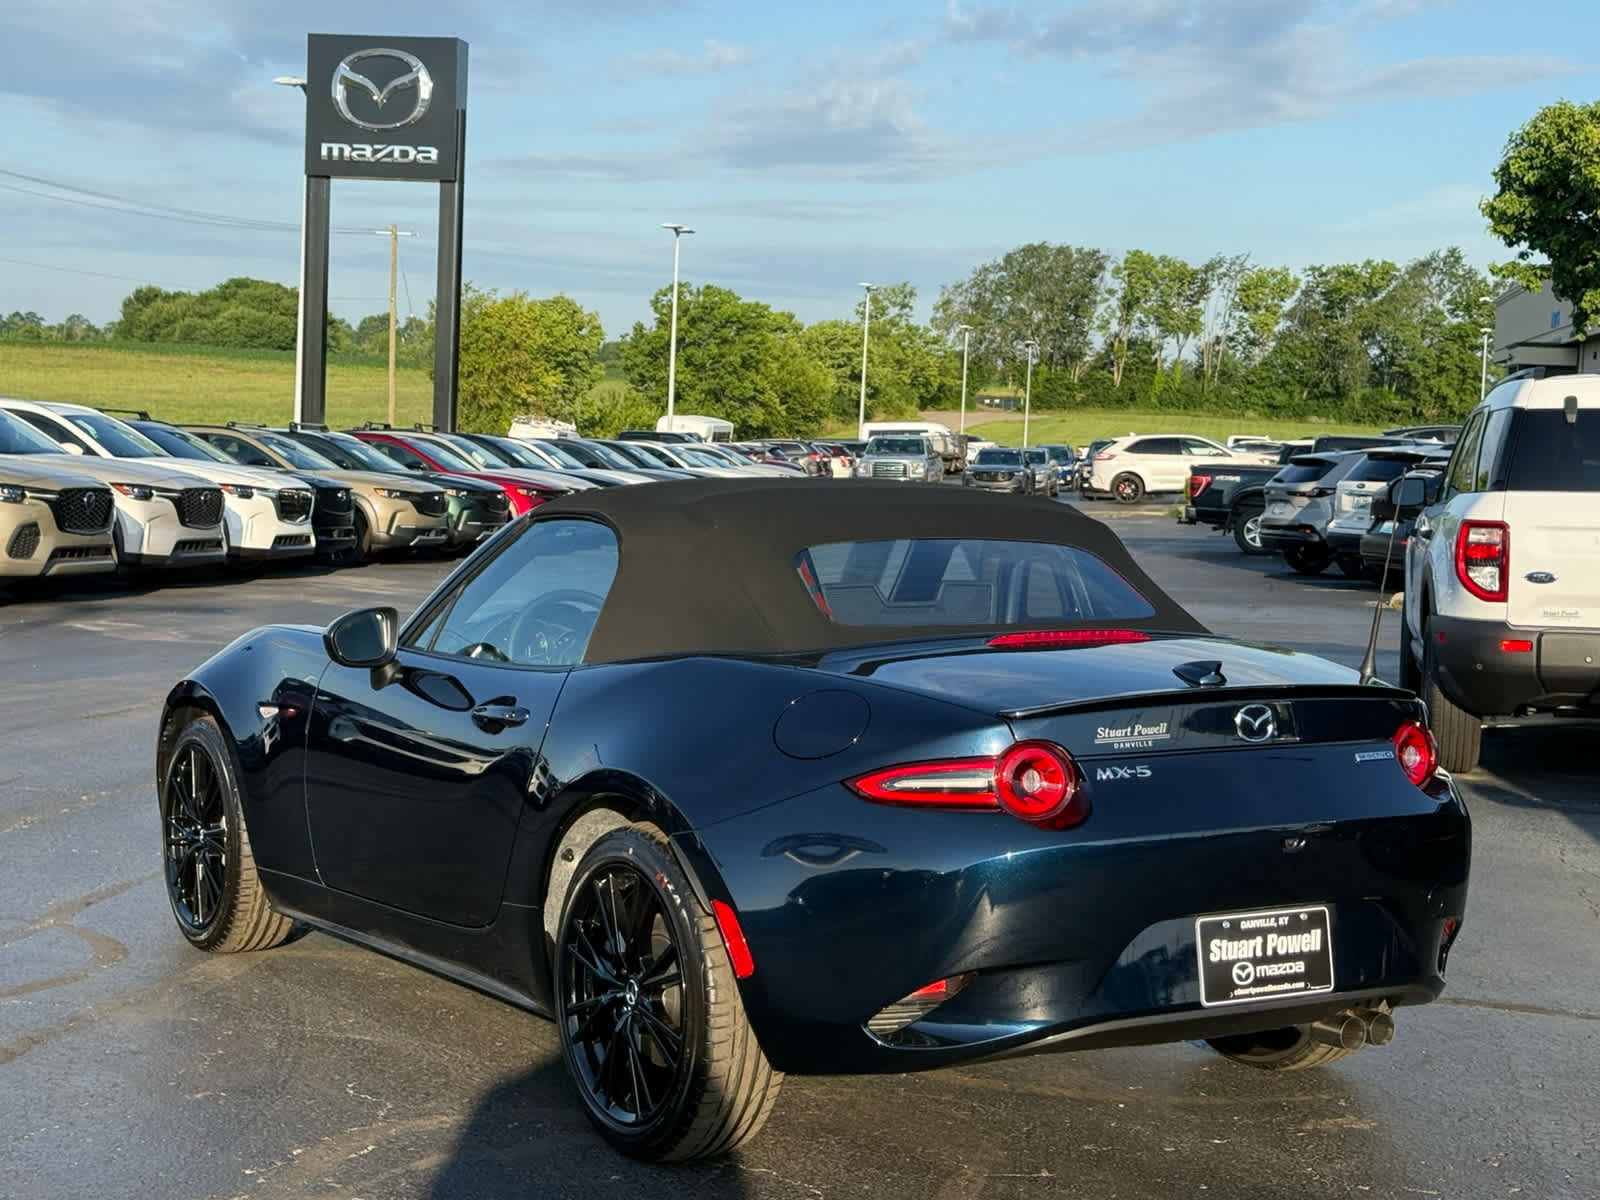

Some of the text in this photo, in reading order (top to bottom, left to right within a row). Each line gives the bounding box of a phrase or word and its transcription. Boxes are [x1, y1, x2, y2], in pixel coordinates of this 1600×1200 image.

[320, 142, 439, 164] mazda
[1096, 722, 1168, 739] Stuart Powell
[1113, 740, 1153, 749] DANVILLE
[1096, 765, 1153, 781] MX-5
[1209, 928, 1322, 962] Stuart Powell
[1256, 961, 1305, 978] mazda
